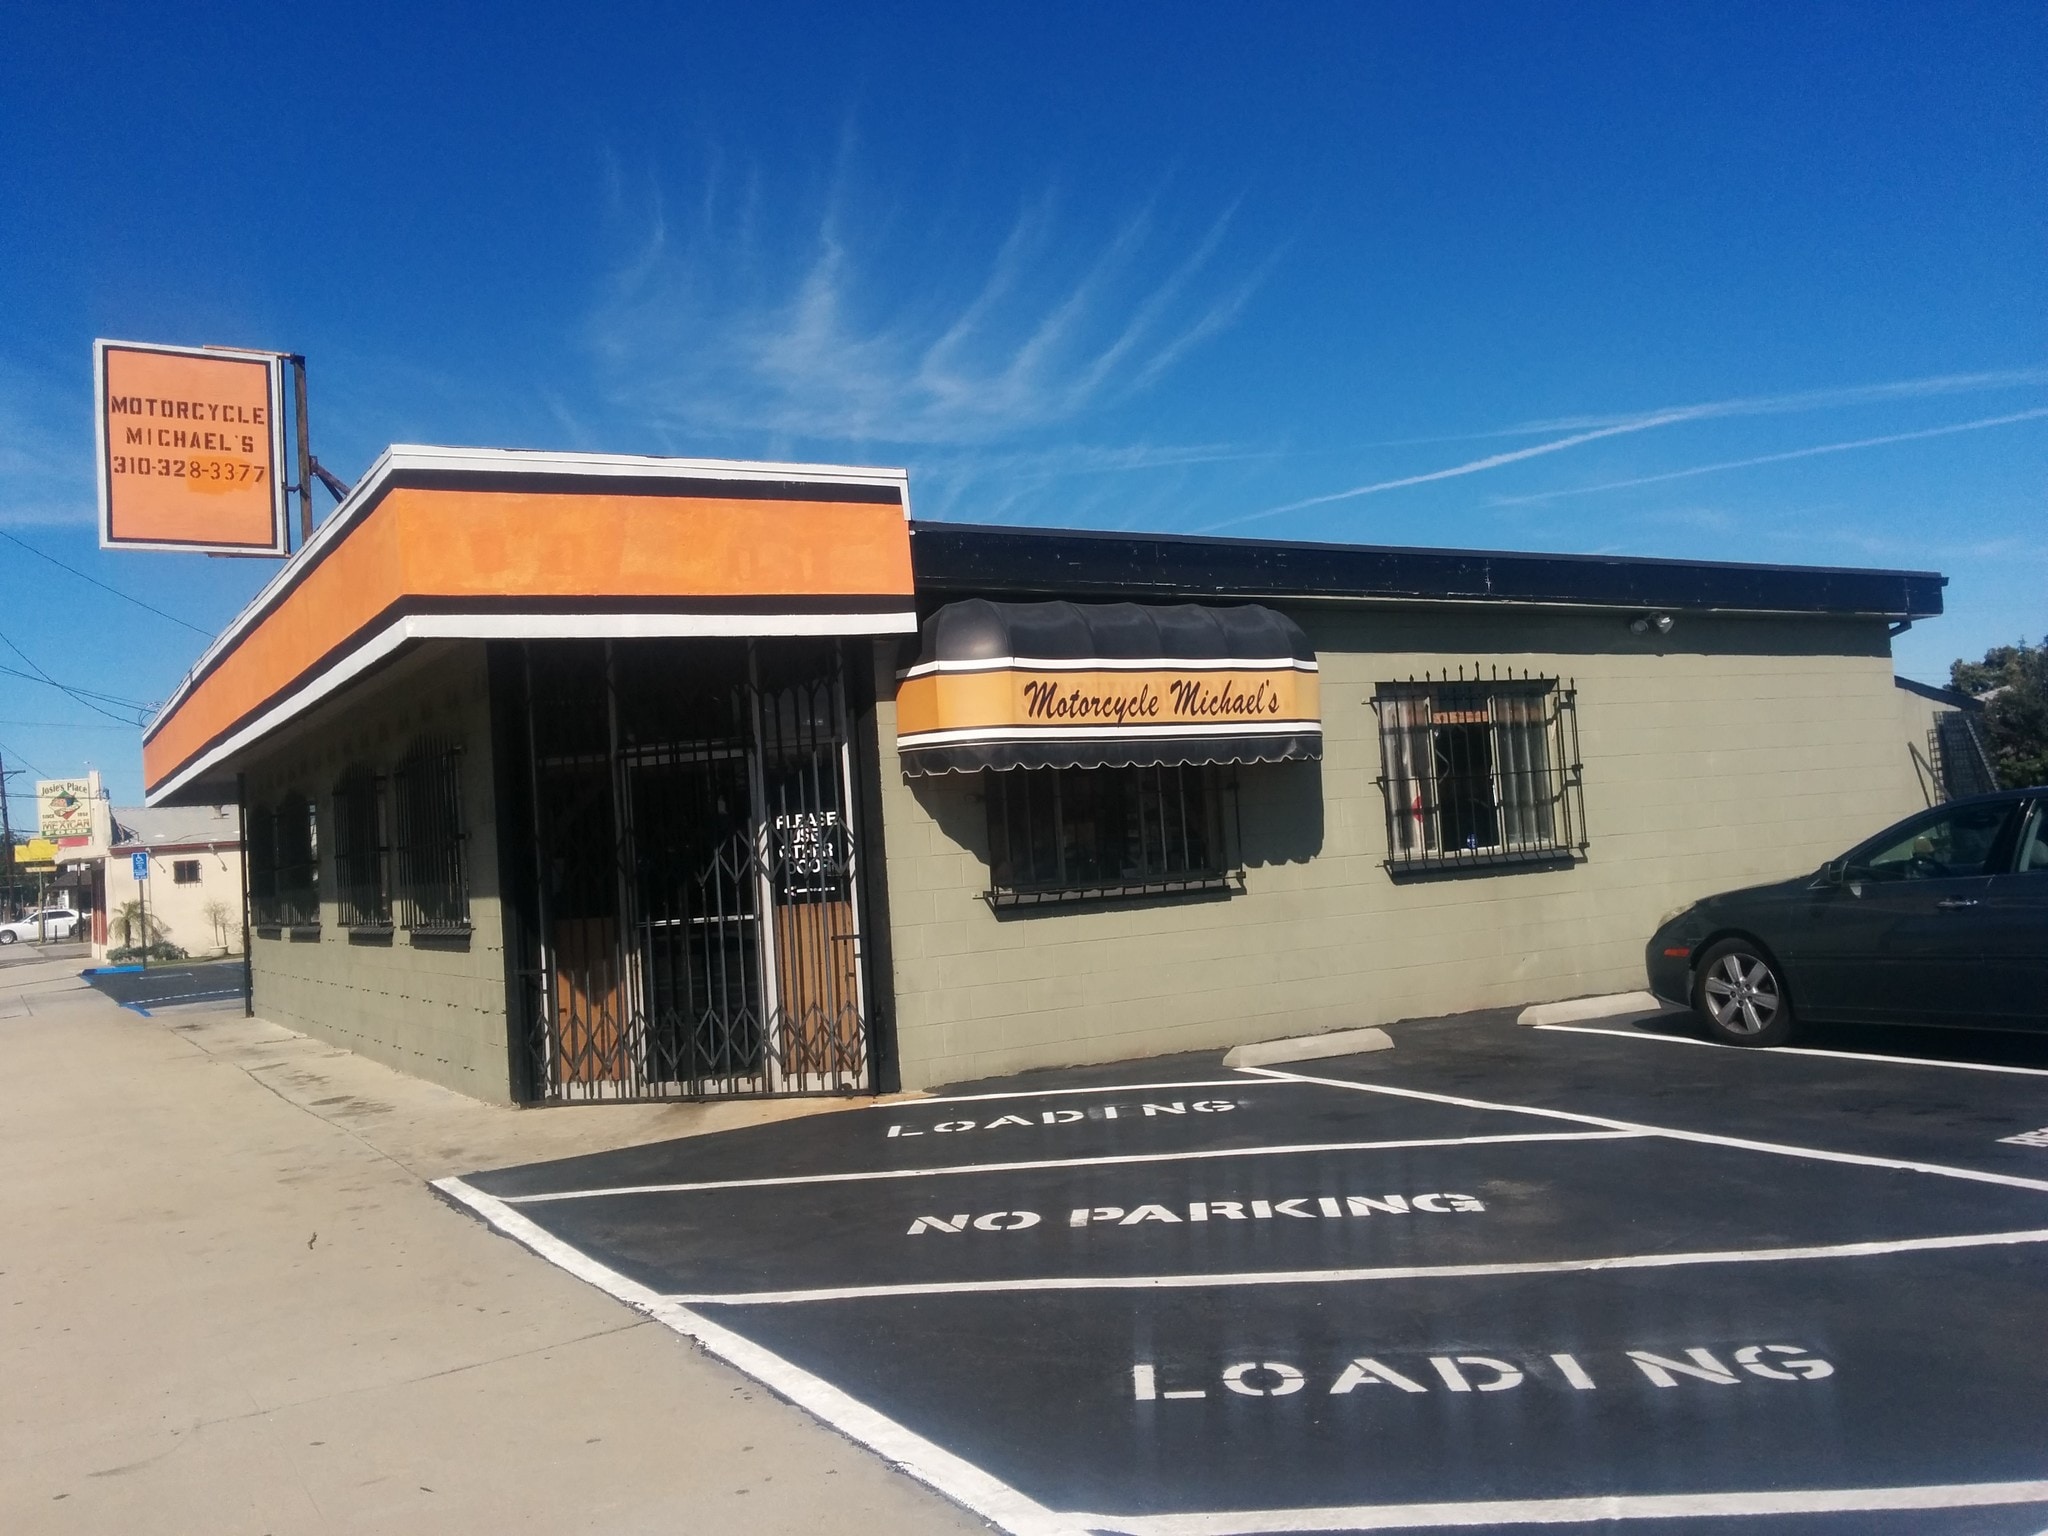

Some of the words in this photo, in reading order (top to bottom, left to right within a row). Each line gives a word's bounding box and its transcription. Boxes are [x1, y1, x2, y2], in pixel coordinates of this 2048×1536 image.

[110, 395, 265, 425] MOTORCYCLE
[126, 427, 254, 453] MICHAEL'S
[113, 456, 265, 482] 310-328-3377
[1023, 680, 1159, 728] Motorcycle
[1170, 679, 1279, 717] Michael's
[41, 783, 64, 796] Josie's
[66, 782, 87, 793] Place
[42, 819, 90, 830] MEXICAN
[776, 811, 837, 830] PLEASE
[886, 1100, 1235, 1138] LOADING
[907, 1213, 1041, 1236] NO
[1070, 1193, 1486, 1228] PARKING
[1133, 1344, 1835, 1400] LOADING
